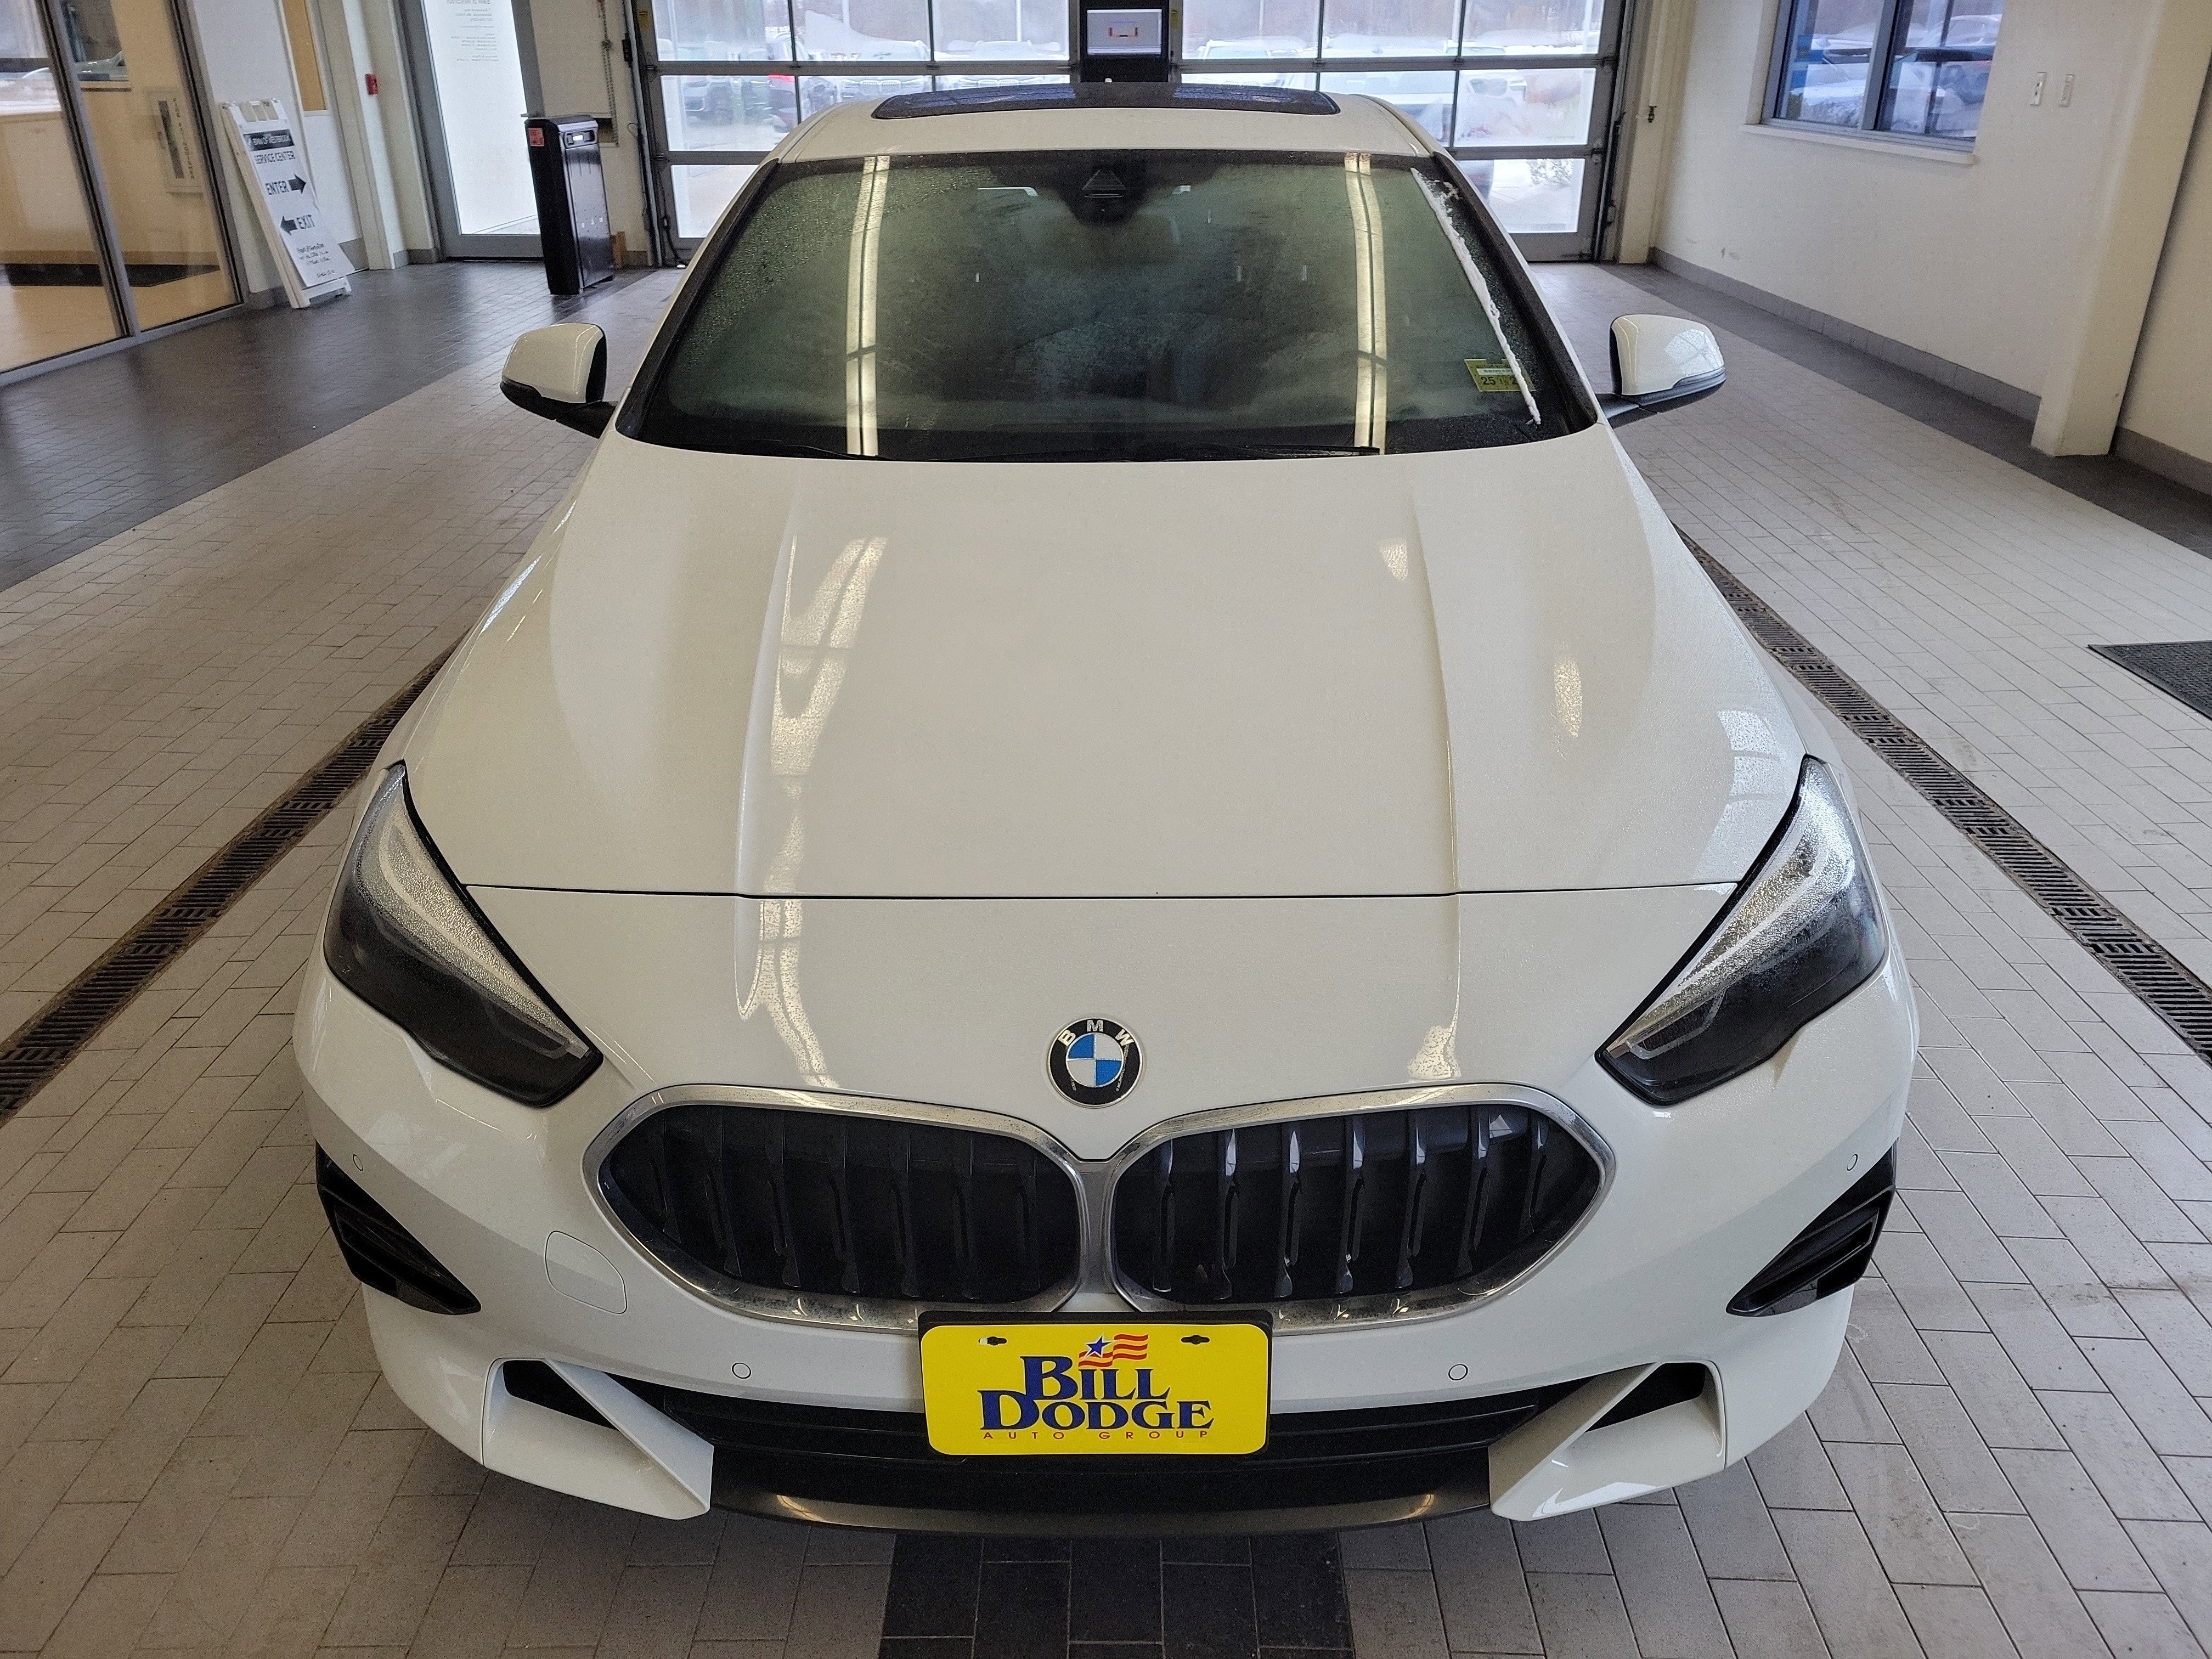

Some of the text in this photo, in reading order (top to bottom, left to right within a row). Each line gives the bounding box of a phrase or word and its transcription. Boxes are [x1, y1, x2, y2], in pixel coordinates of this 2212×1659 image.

[254, 151, 296, 164] SERVICE CENTER
[265, 180, 289, 195] ENTER
[296, 215, 315, 229] EXIT
[1481, 376, 1496, 385] 25
[1058, 1019, 1135, 1046] BMW
[1019, 1355, 1171, 1400] BILL
[977, 1390, 1215, 1430] DODGE
[983, 1430, 1209, 1440] AUTO GROUP
